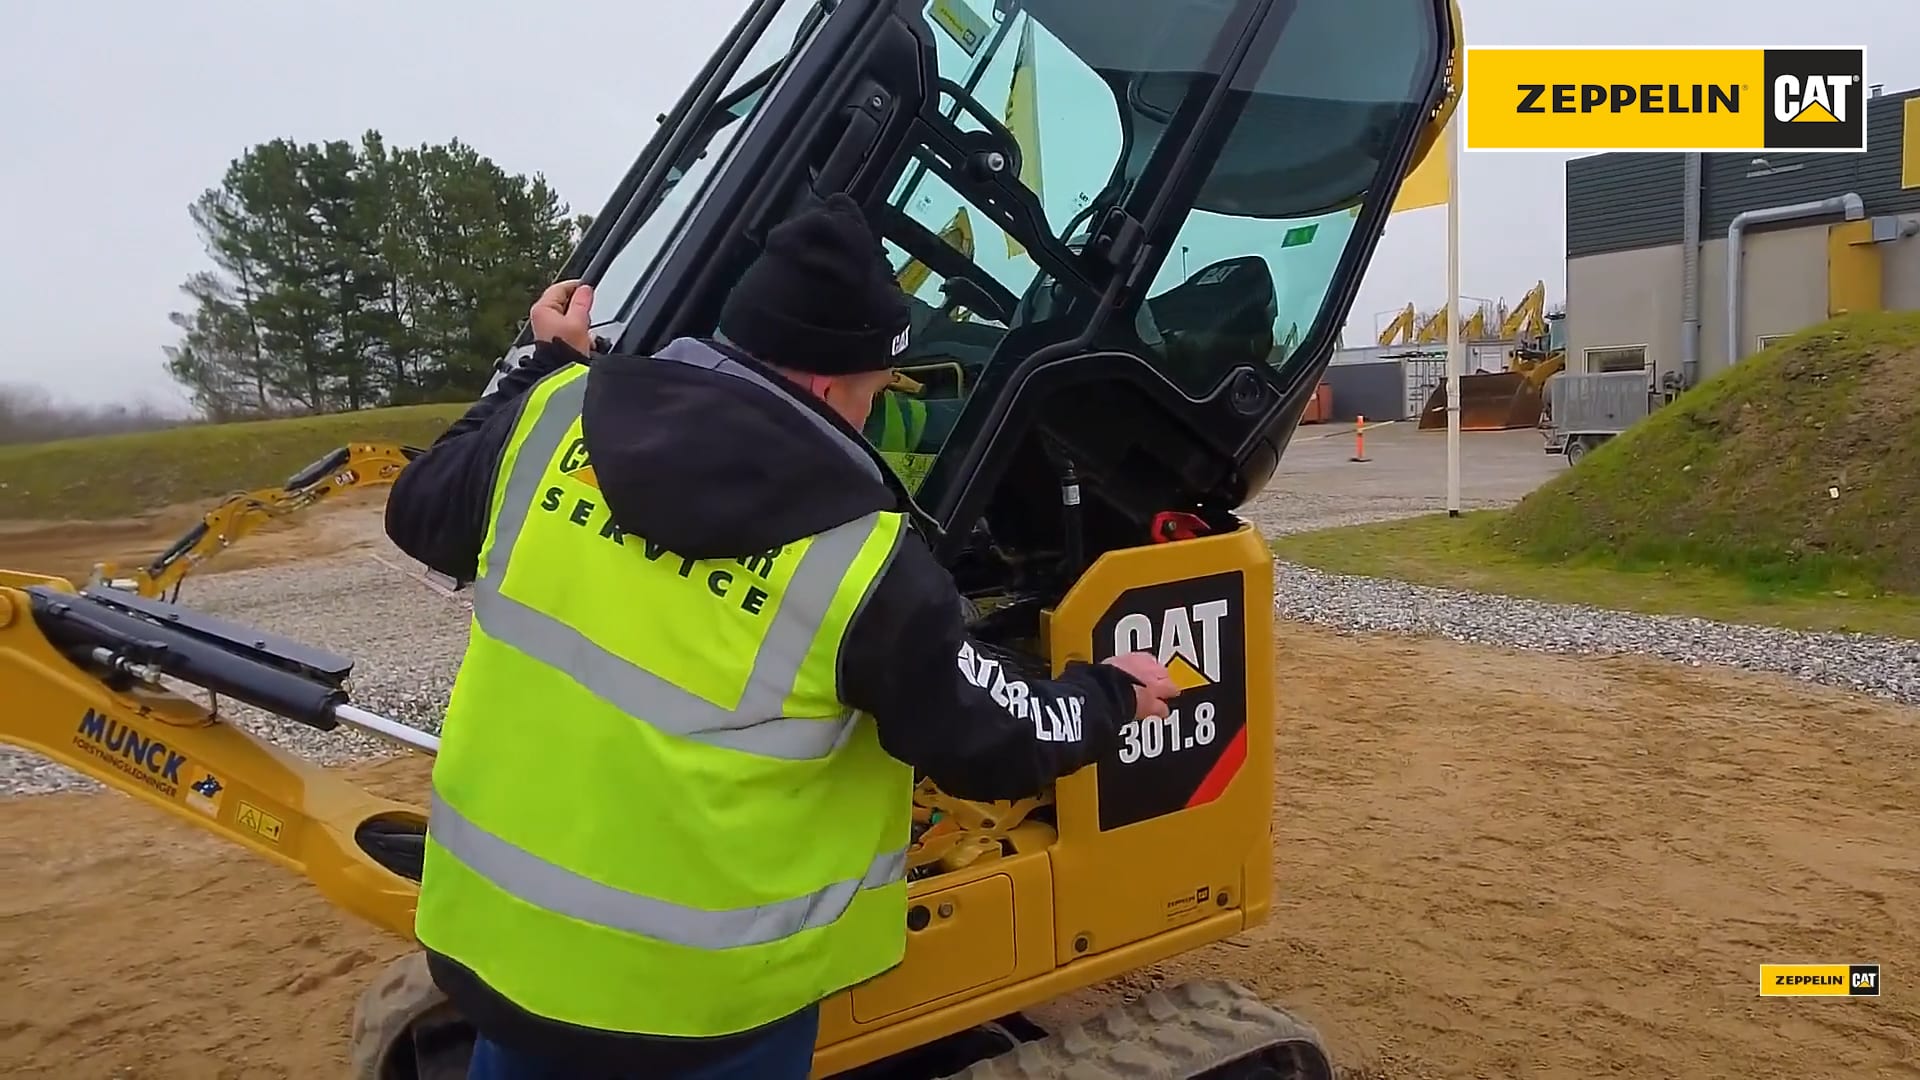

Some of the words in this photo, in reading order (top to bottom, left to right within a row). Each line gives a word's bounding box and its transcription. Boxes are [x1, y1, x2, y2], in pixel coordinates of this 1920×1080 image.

[1114, 599, 1228, 683] CAT
[77, 707, 187, 785] MUNCK
[1118, 702, 1216, 764] 301.8
